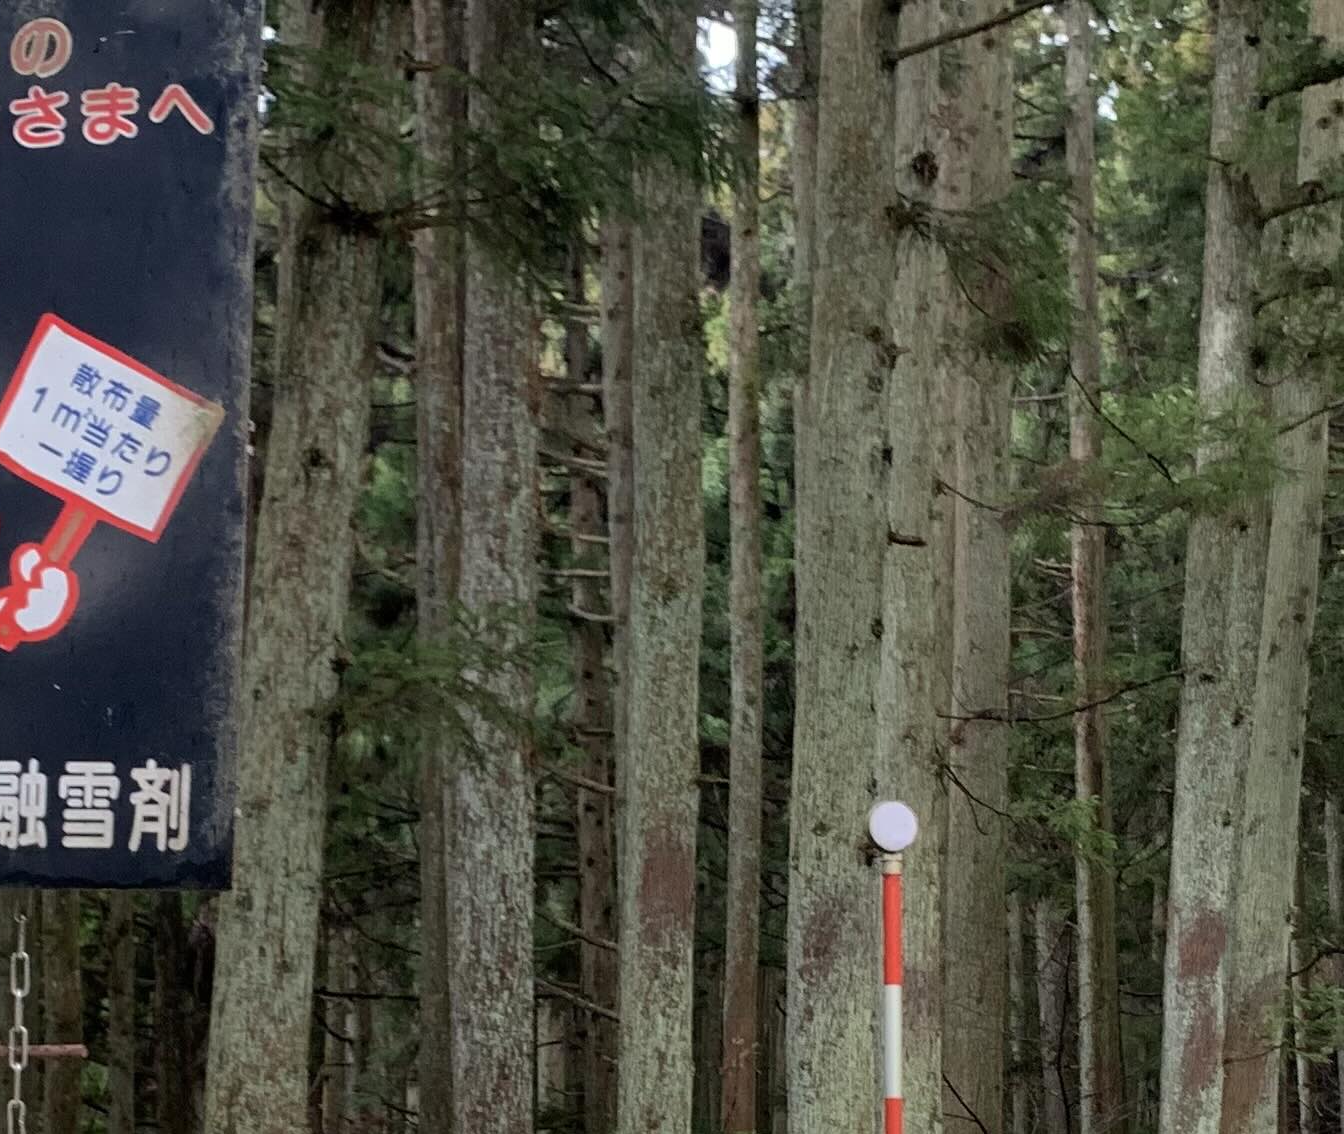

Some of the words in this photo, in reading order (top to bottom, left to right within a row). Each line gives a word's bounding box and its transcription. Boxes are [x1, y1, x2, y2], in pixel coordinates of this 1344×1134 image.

[69, 362, 162, 431] 散布量
[38, 442, 124, 496] 一握り
